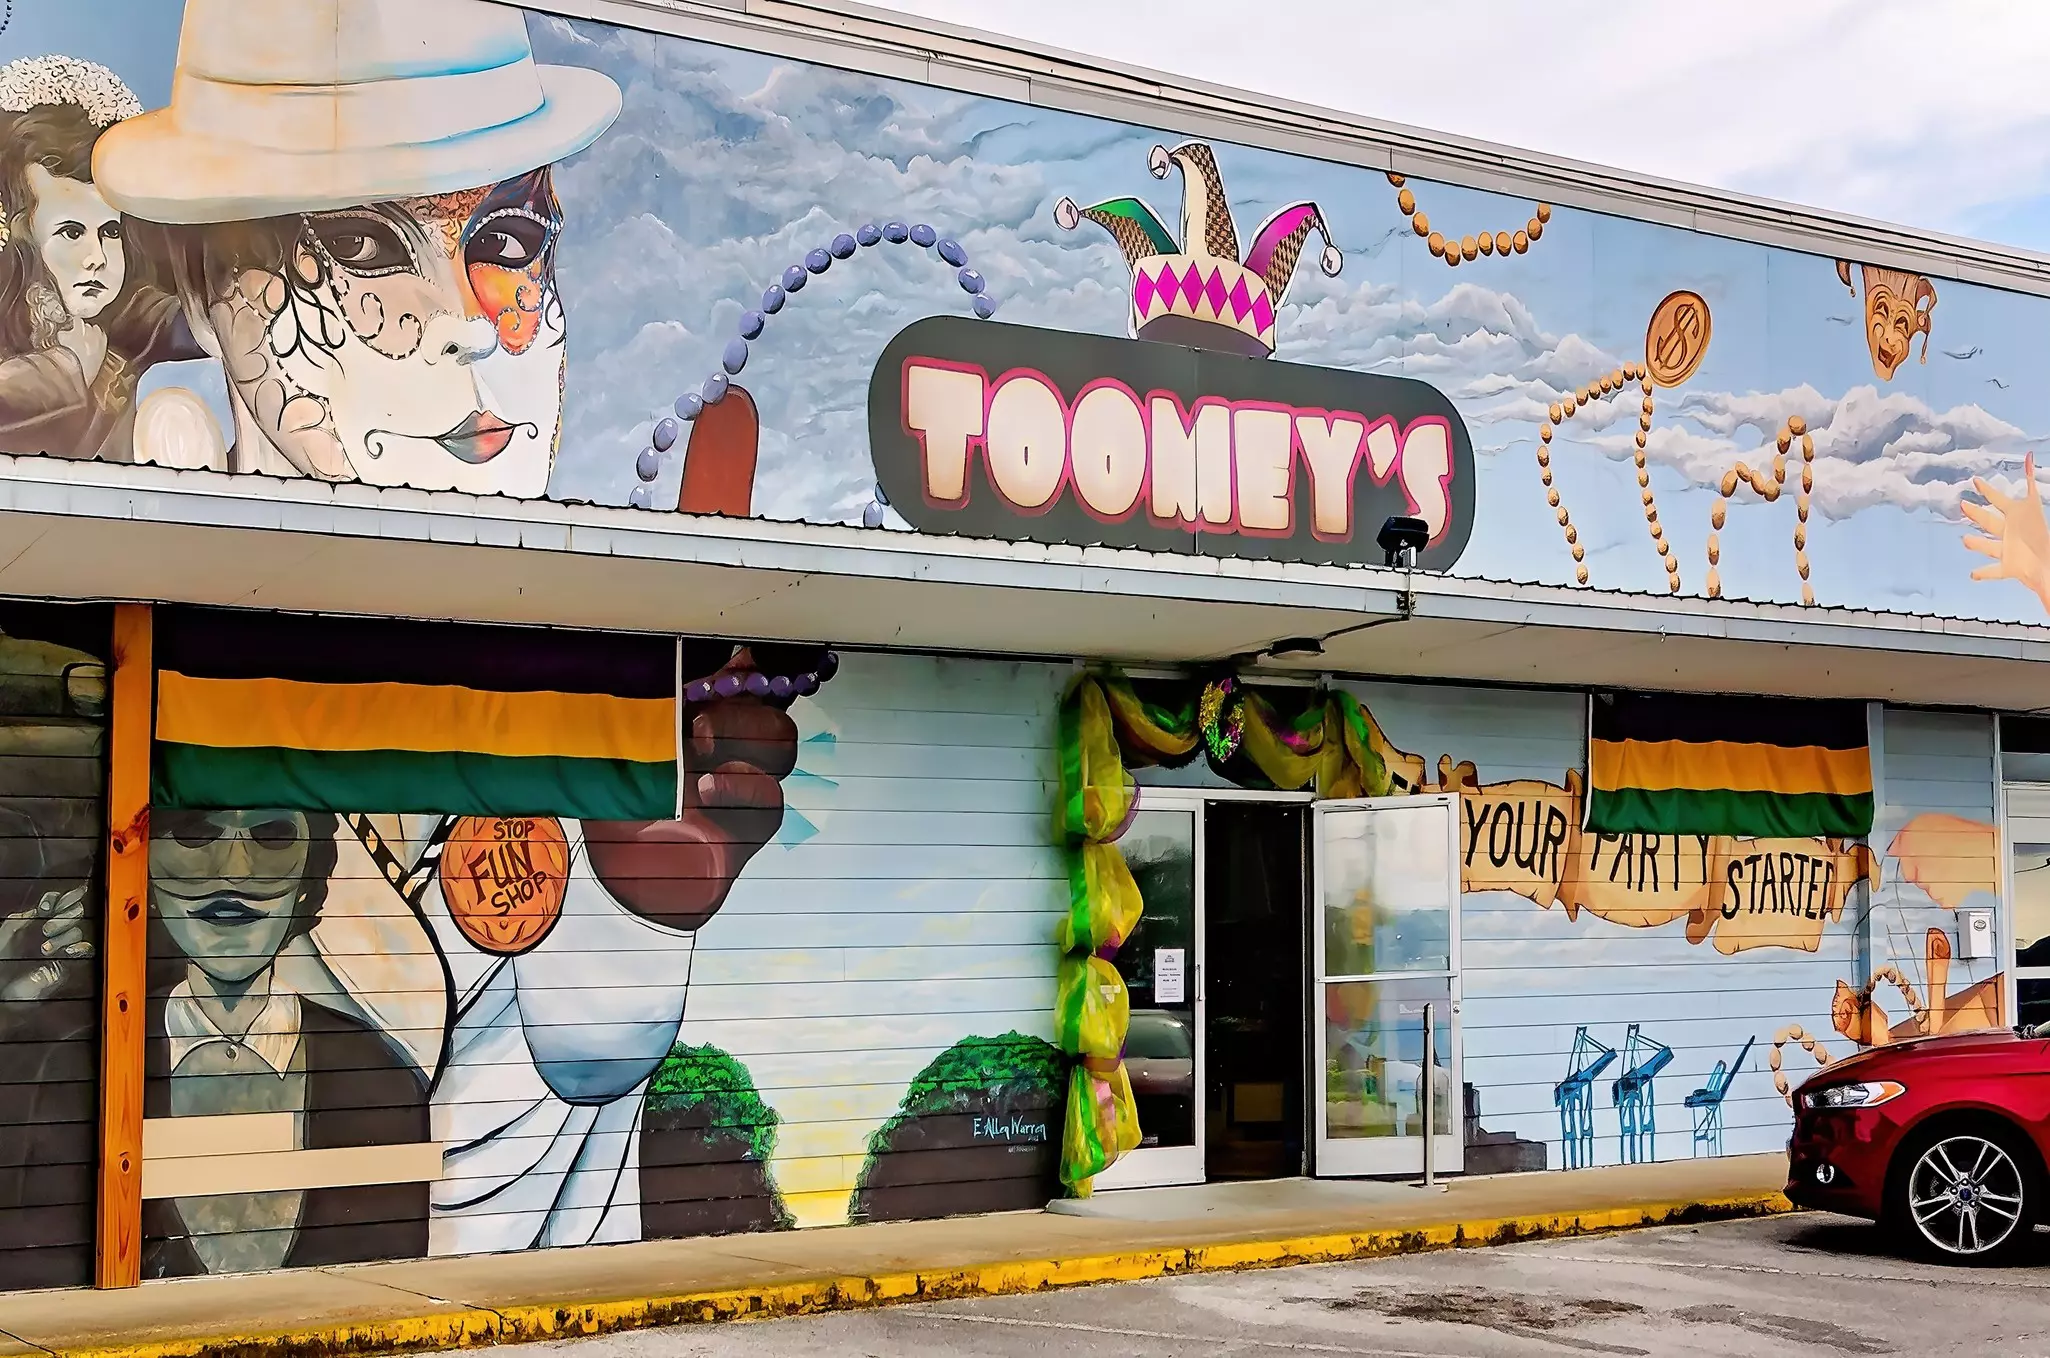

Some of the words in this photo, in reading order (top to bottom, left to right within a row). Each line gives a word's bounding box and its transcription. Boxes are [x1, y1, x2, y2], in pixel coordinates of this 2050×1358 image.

[901, 356, 1452, 548] TOOMEY'S
[494, 820, 535, 839] STOP
[1464, 798, 1567, 884] YOUR
[467, 840, 535, 905] FUN
[491, 871, 547, 916] SHOP
